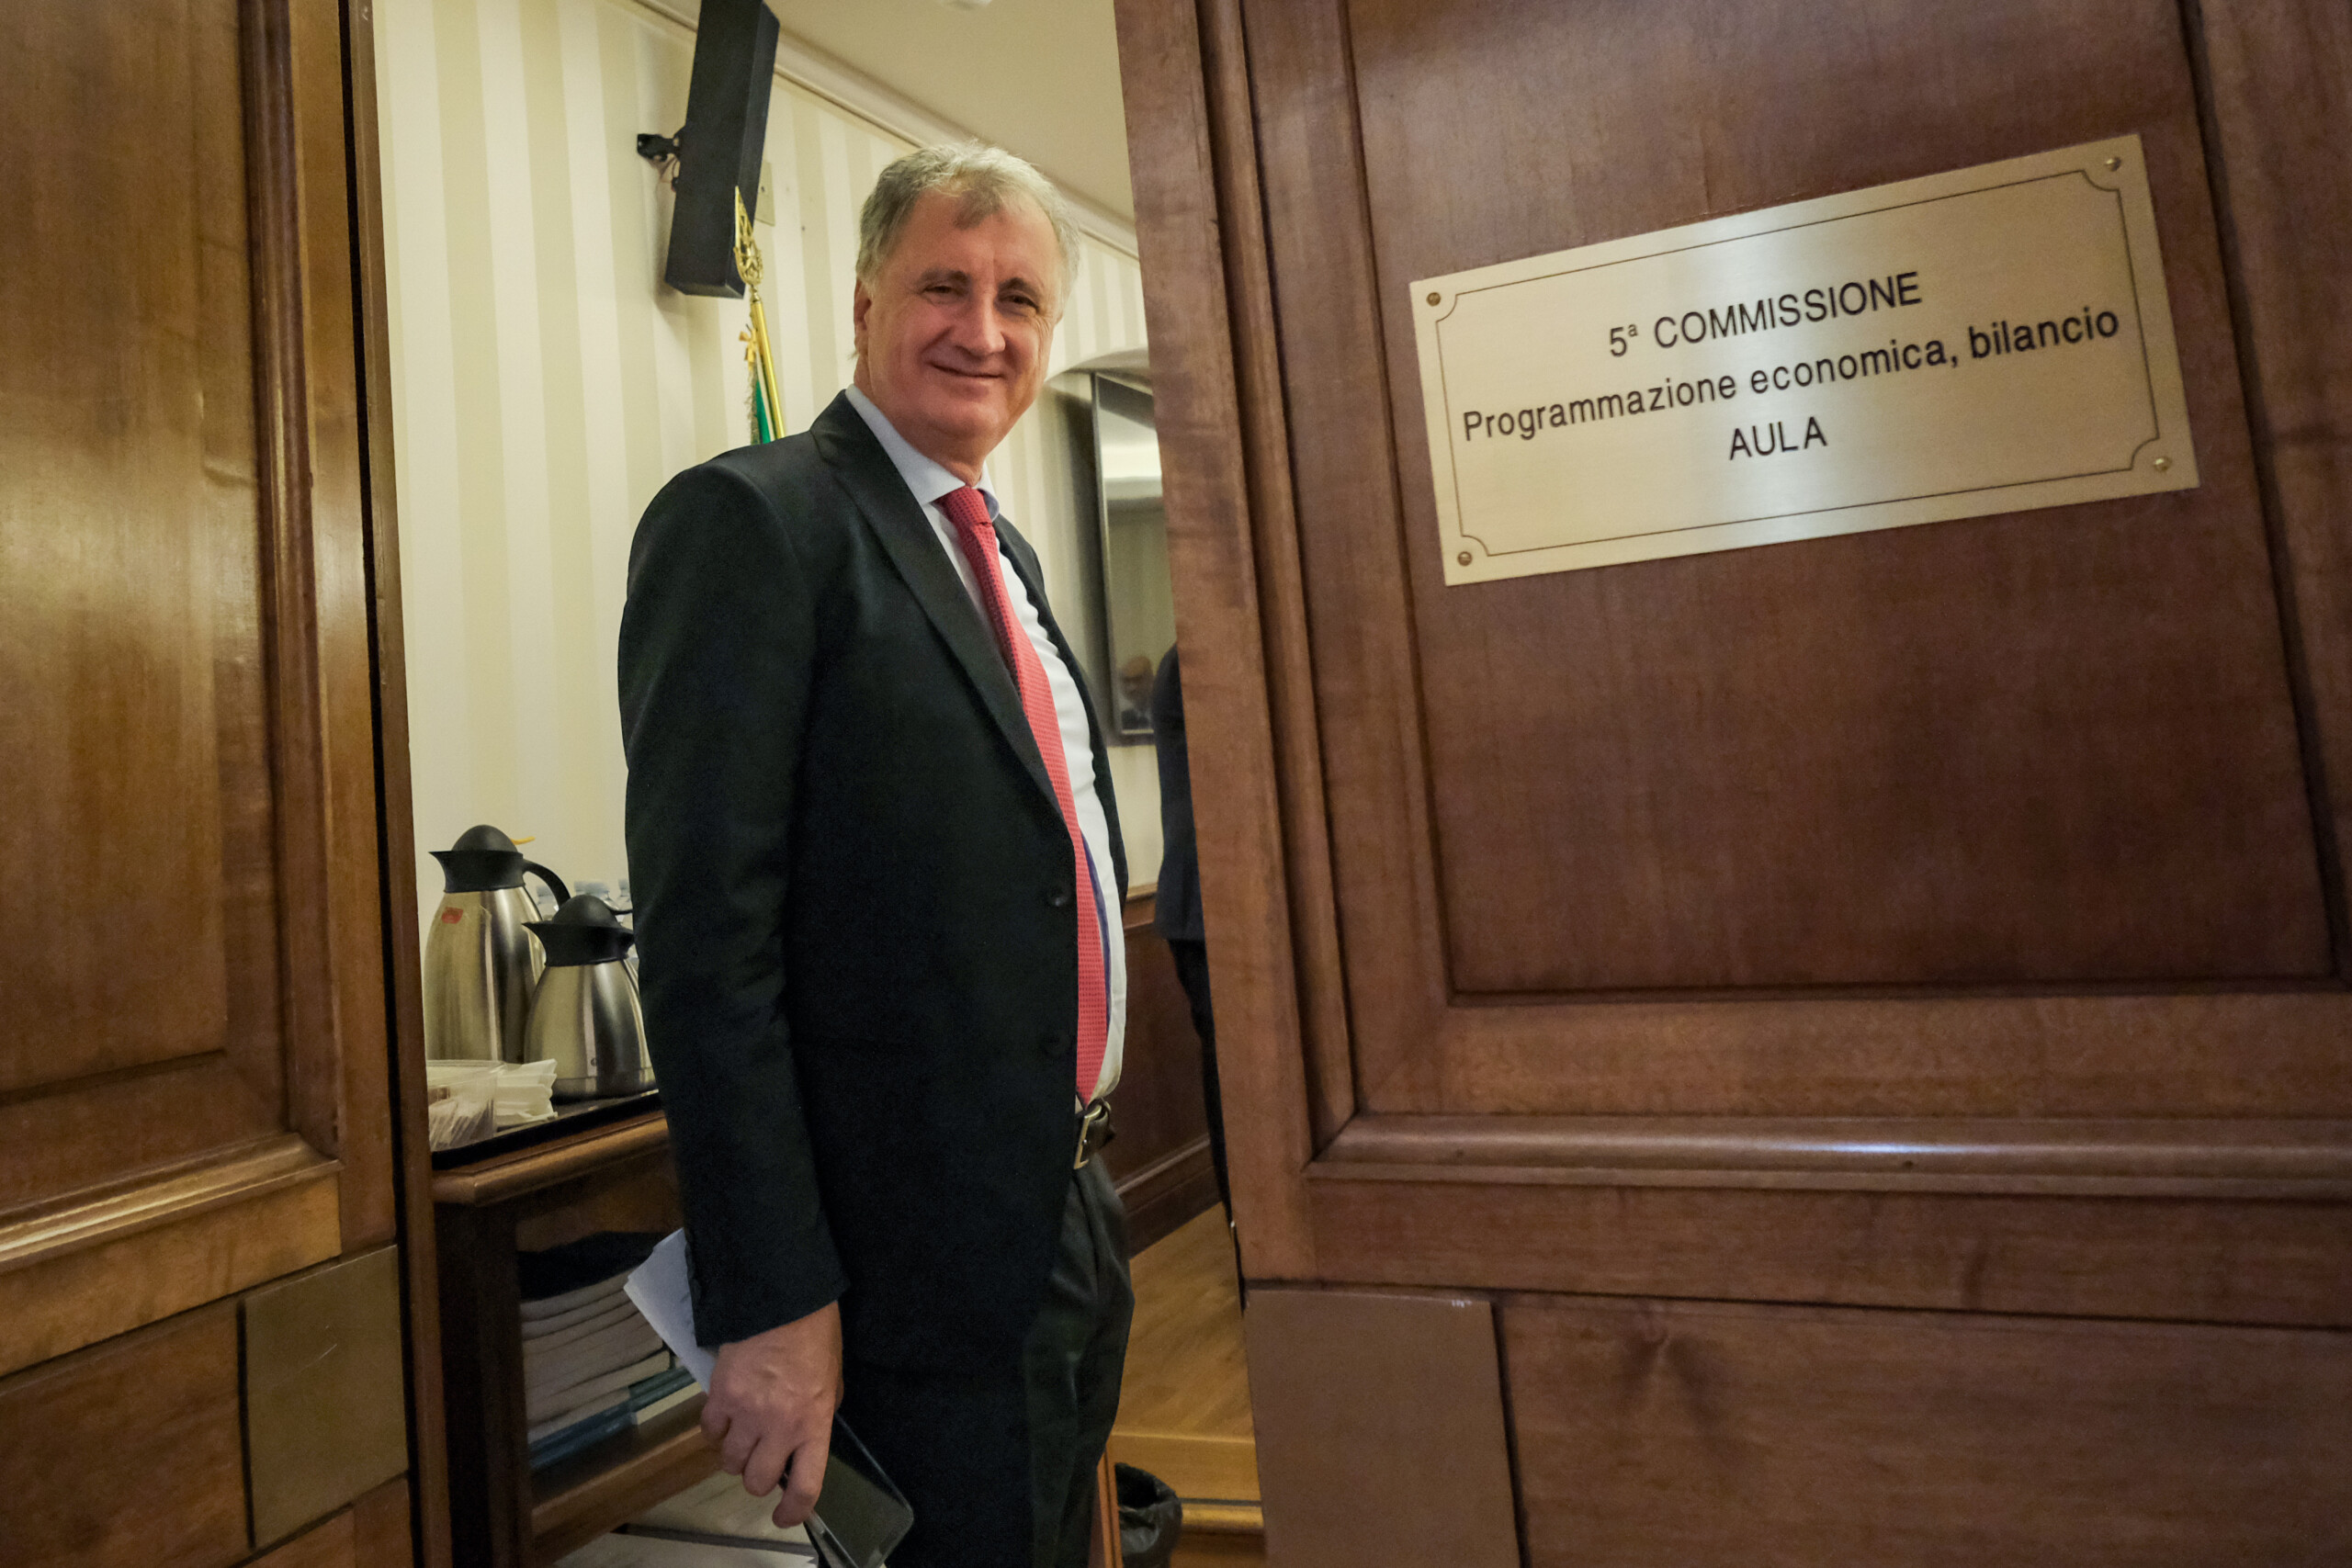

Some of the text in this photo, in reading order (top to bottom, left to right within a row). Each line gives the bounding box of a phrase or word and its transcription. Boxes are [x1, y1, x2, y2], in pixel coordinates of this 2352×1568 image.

[1653, 271, 1923, 349] COMMISSIONE
[1463, 306, 2120, 442] Programmazione economica, bilancio
[1728, 415, 1828, 461] AULA
